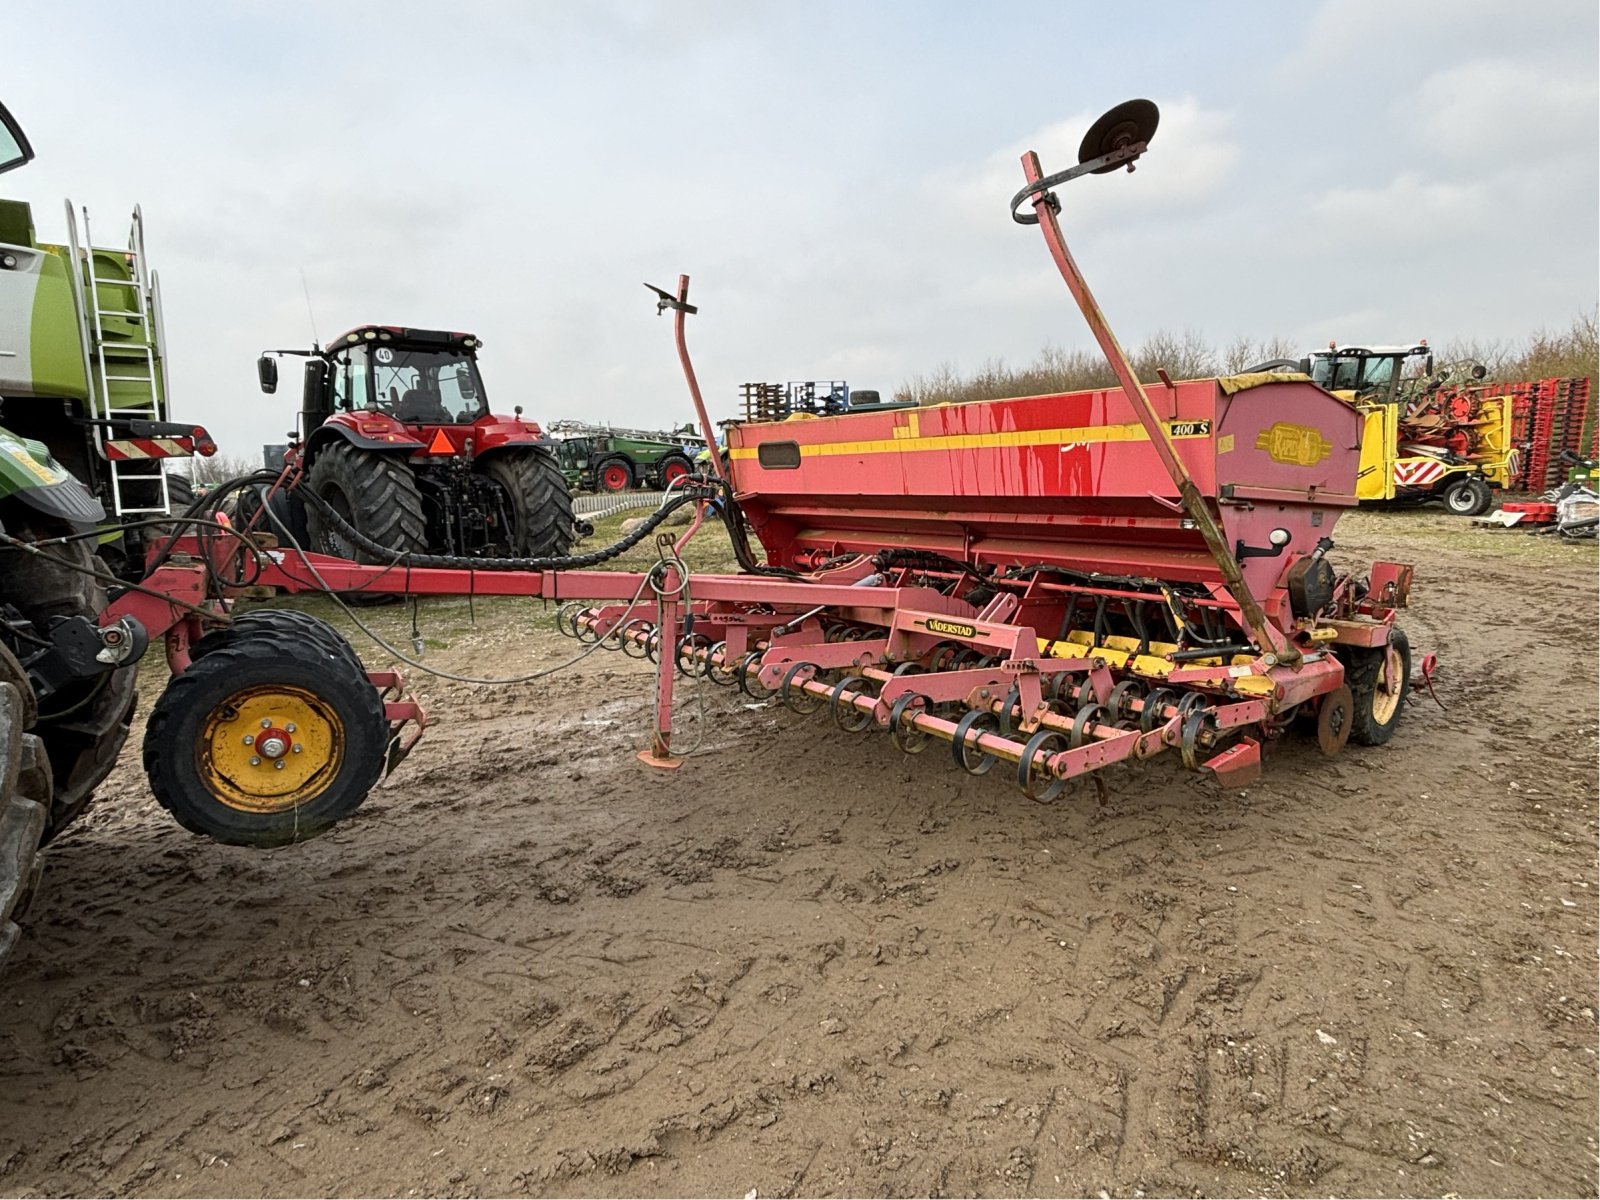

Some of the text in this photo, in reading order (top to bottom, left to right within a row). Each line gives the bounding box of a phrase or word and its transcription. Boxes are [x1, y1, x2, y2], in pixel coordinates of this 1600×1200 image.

[378, 350, 390, 360] 40
[1173, 423, 1209, 436] 400 S
[929, 620, 973, 636] VÄDERSTAD
